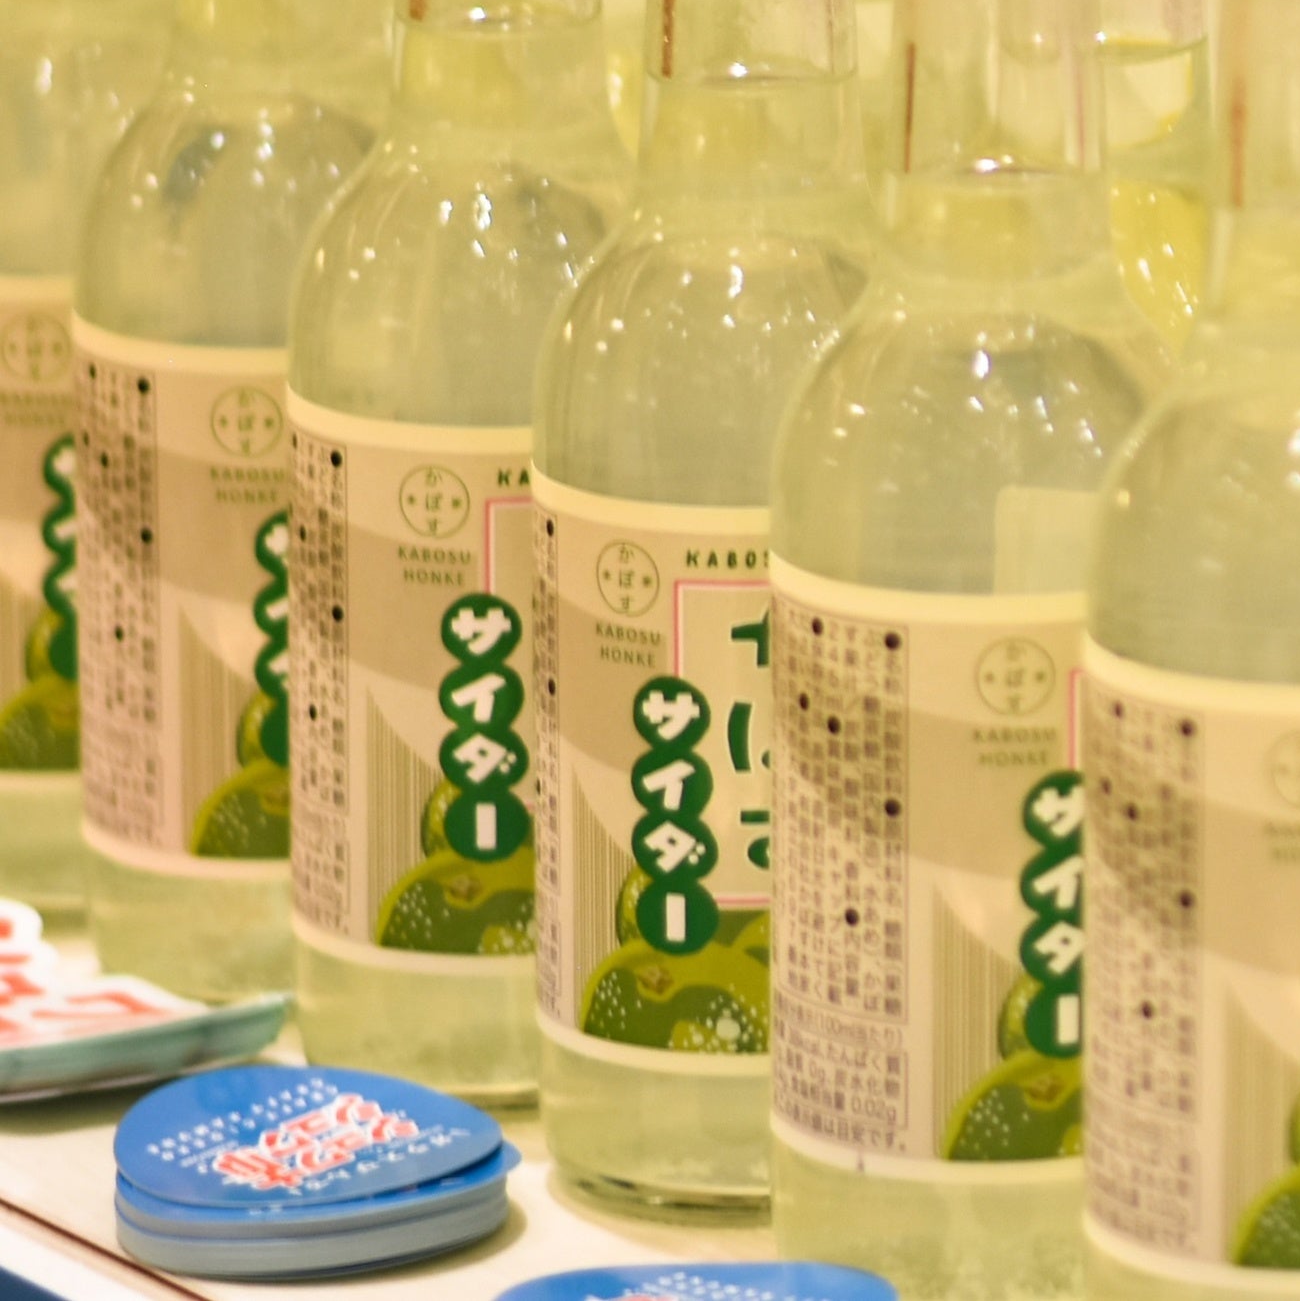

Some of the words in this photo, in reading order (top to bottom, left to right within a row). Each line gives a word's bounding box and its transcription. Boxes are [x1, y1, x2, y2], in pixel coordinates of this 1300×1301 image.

[398, 545, 471, 565] KABOSU
[403, 568, 464, 586] HONKE
[595, 621, 662, 646] KABOSU
[600, 645, 656, 669] HONKE
[450, 606, 518, 850] サイダー
[641, 691, 707, 944] サイダー
